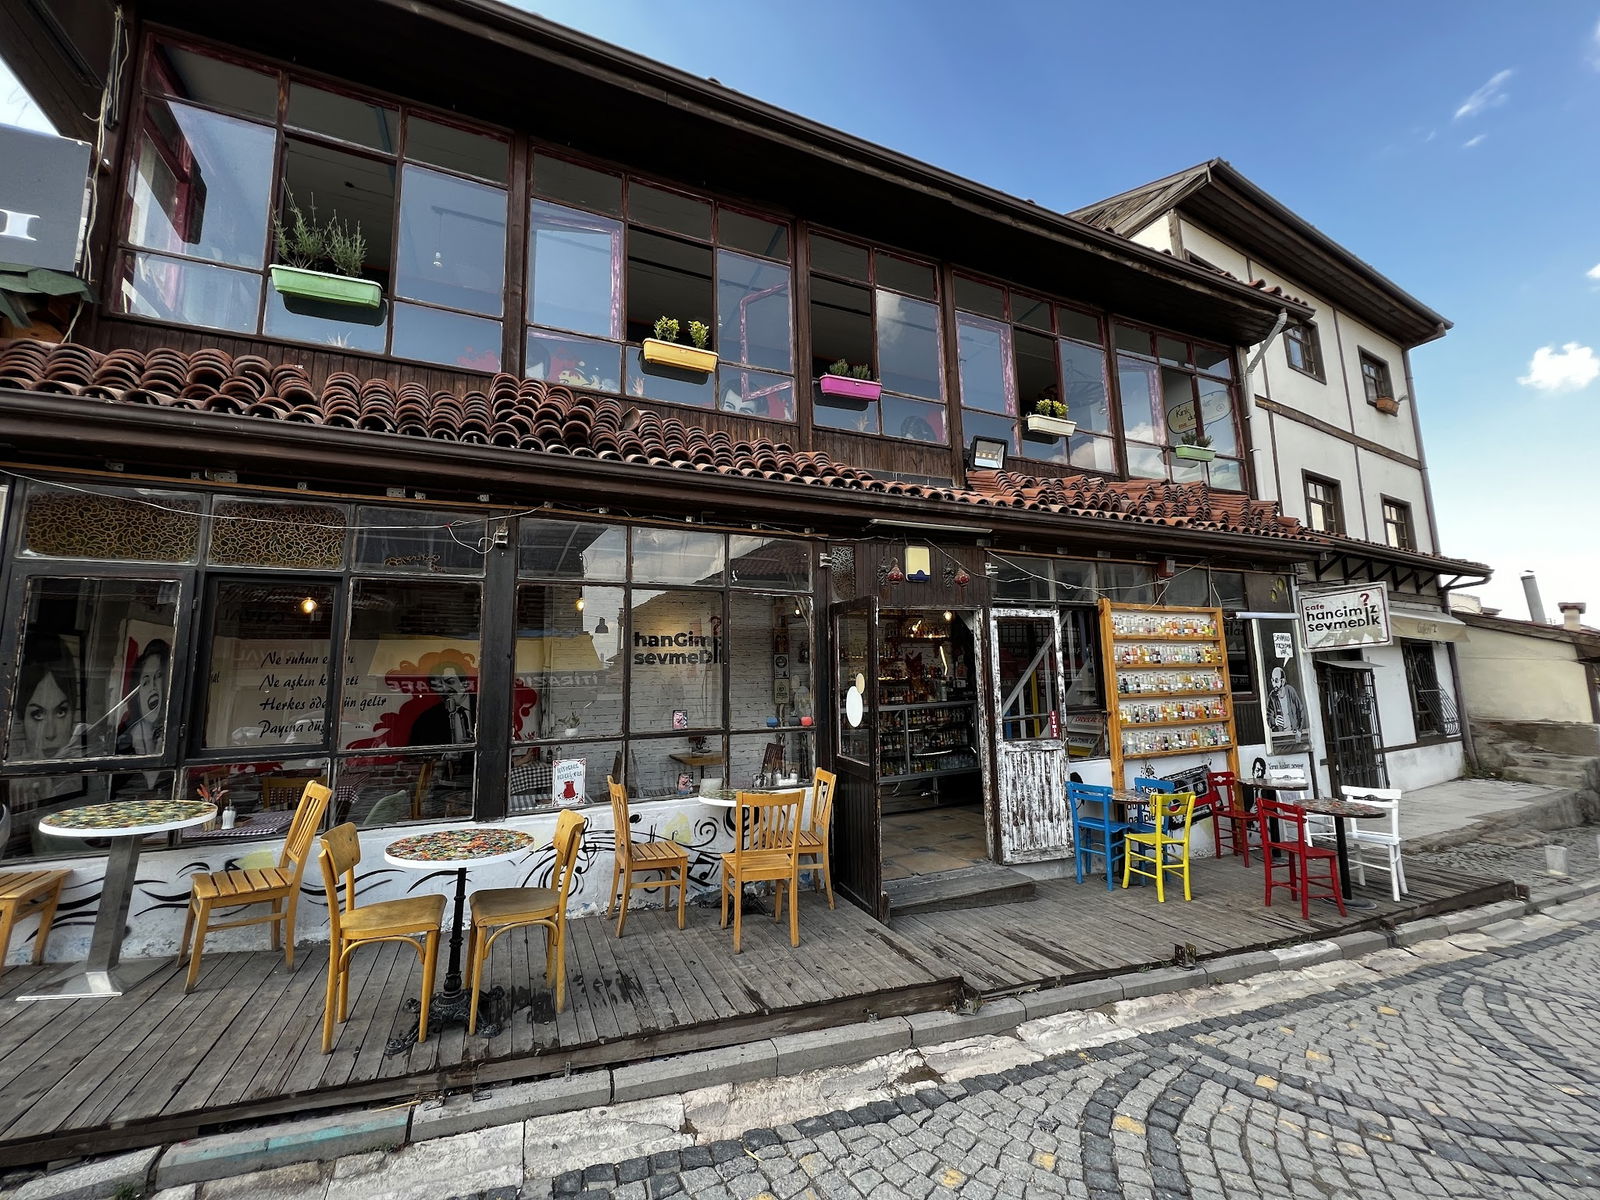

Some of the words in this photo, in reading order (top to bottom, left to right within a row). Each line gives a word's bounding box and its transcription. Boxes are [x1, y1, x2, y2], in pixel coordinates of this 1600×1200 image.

[261, 652, 281, 668] Ne
[285, 652, 318, 665] ruhun
[259, 674, 280, 690] Ne
[283, 673, 315, 690] aşkın
[260, 697, 305, 711] Herkes
[360, 695, 387, 711] gelir
[258, 720, 304, 738] Payına
